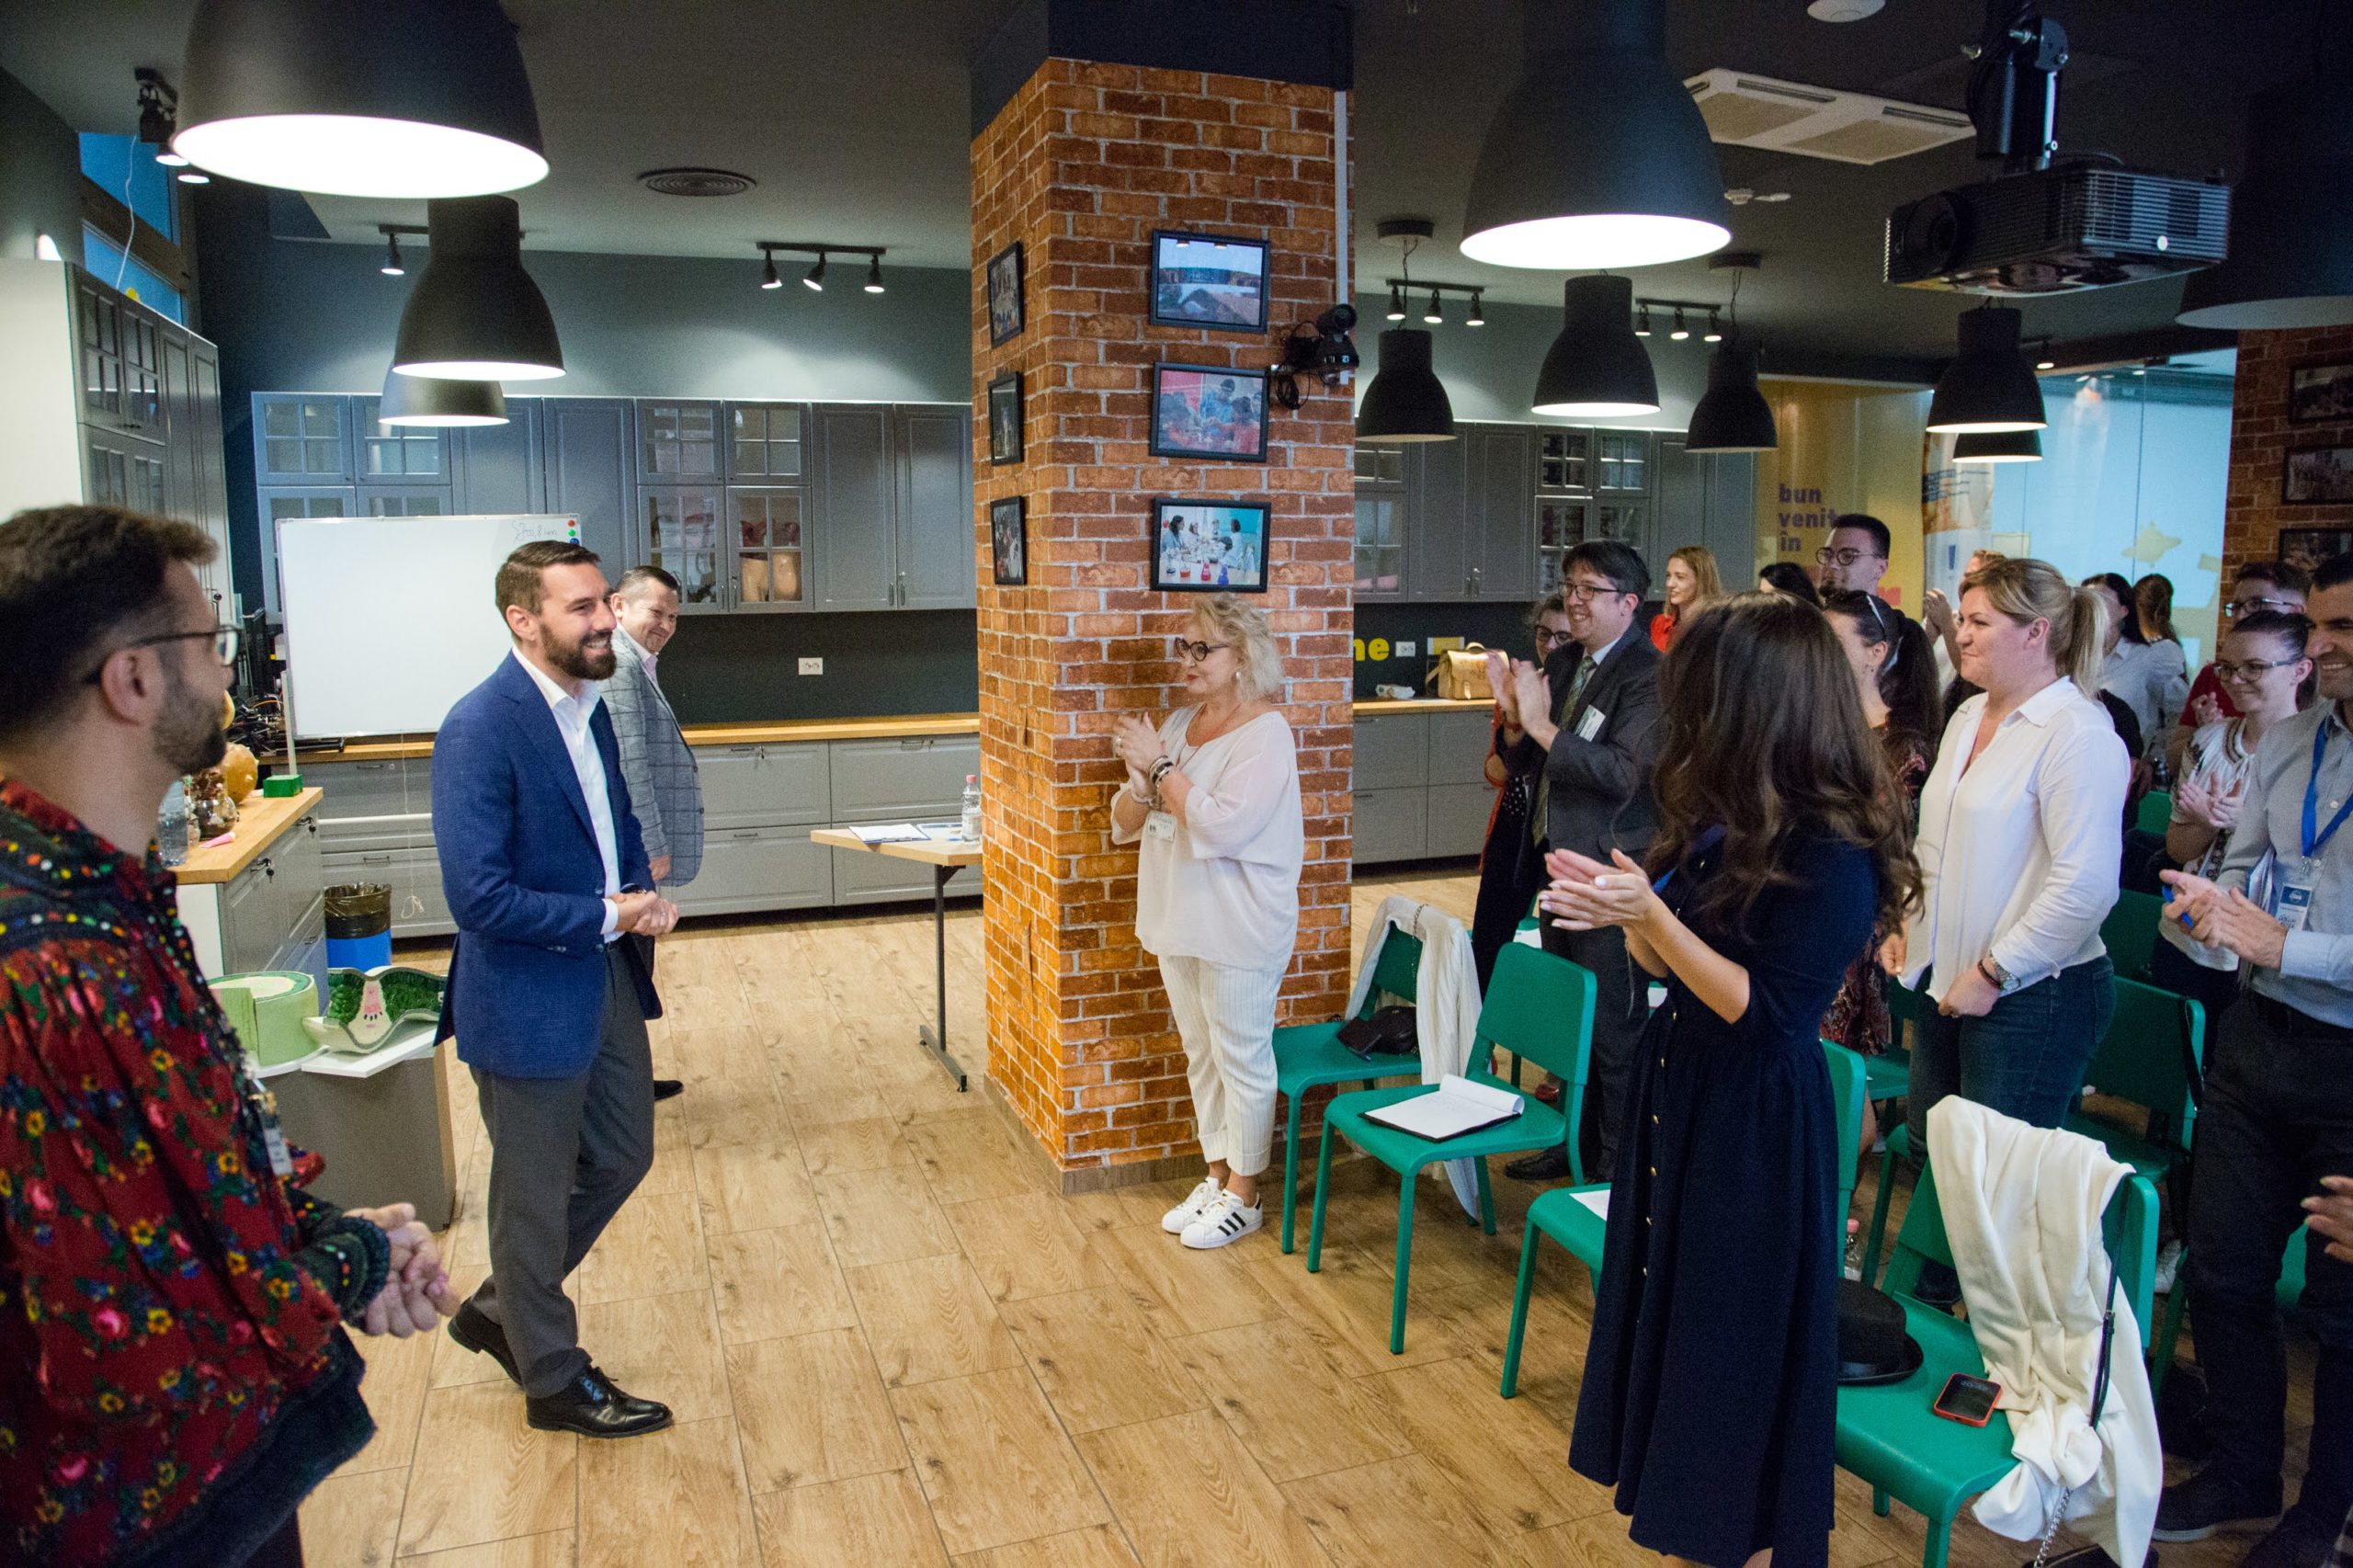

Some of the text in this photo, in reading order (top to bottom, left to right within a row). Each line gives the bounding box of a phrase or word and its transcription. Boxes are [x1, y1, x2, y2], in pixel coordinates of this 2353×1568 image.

[1779, 483, 1821, 504] bun
[1779, 507, 1836, 528] venit
[1780, 530, 1802, 551] în
